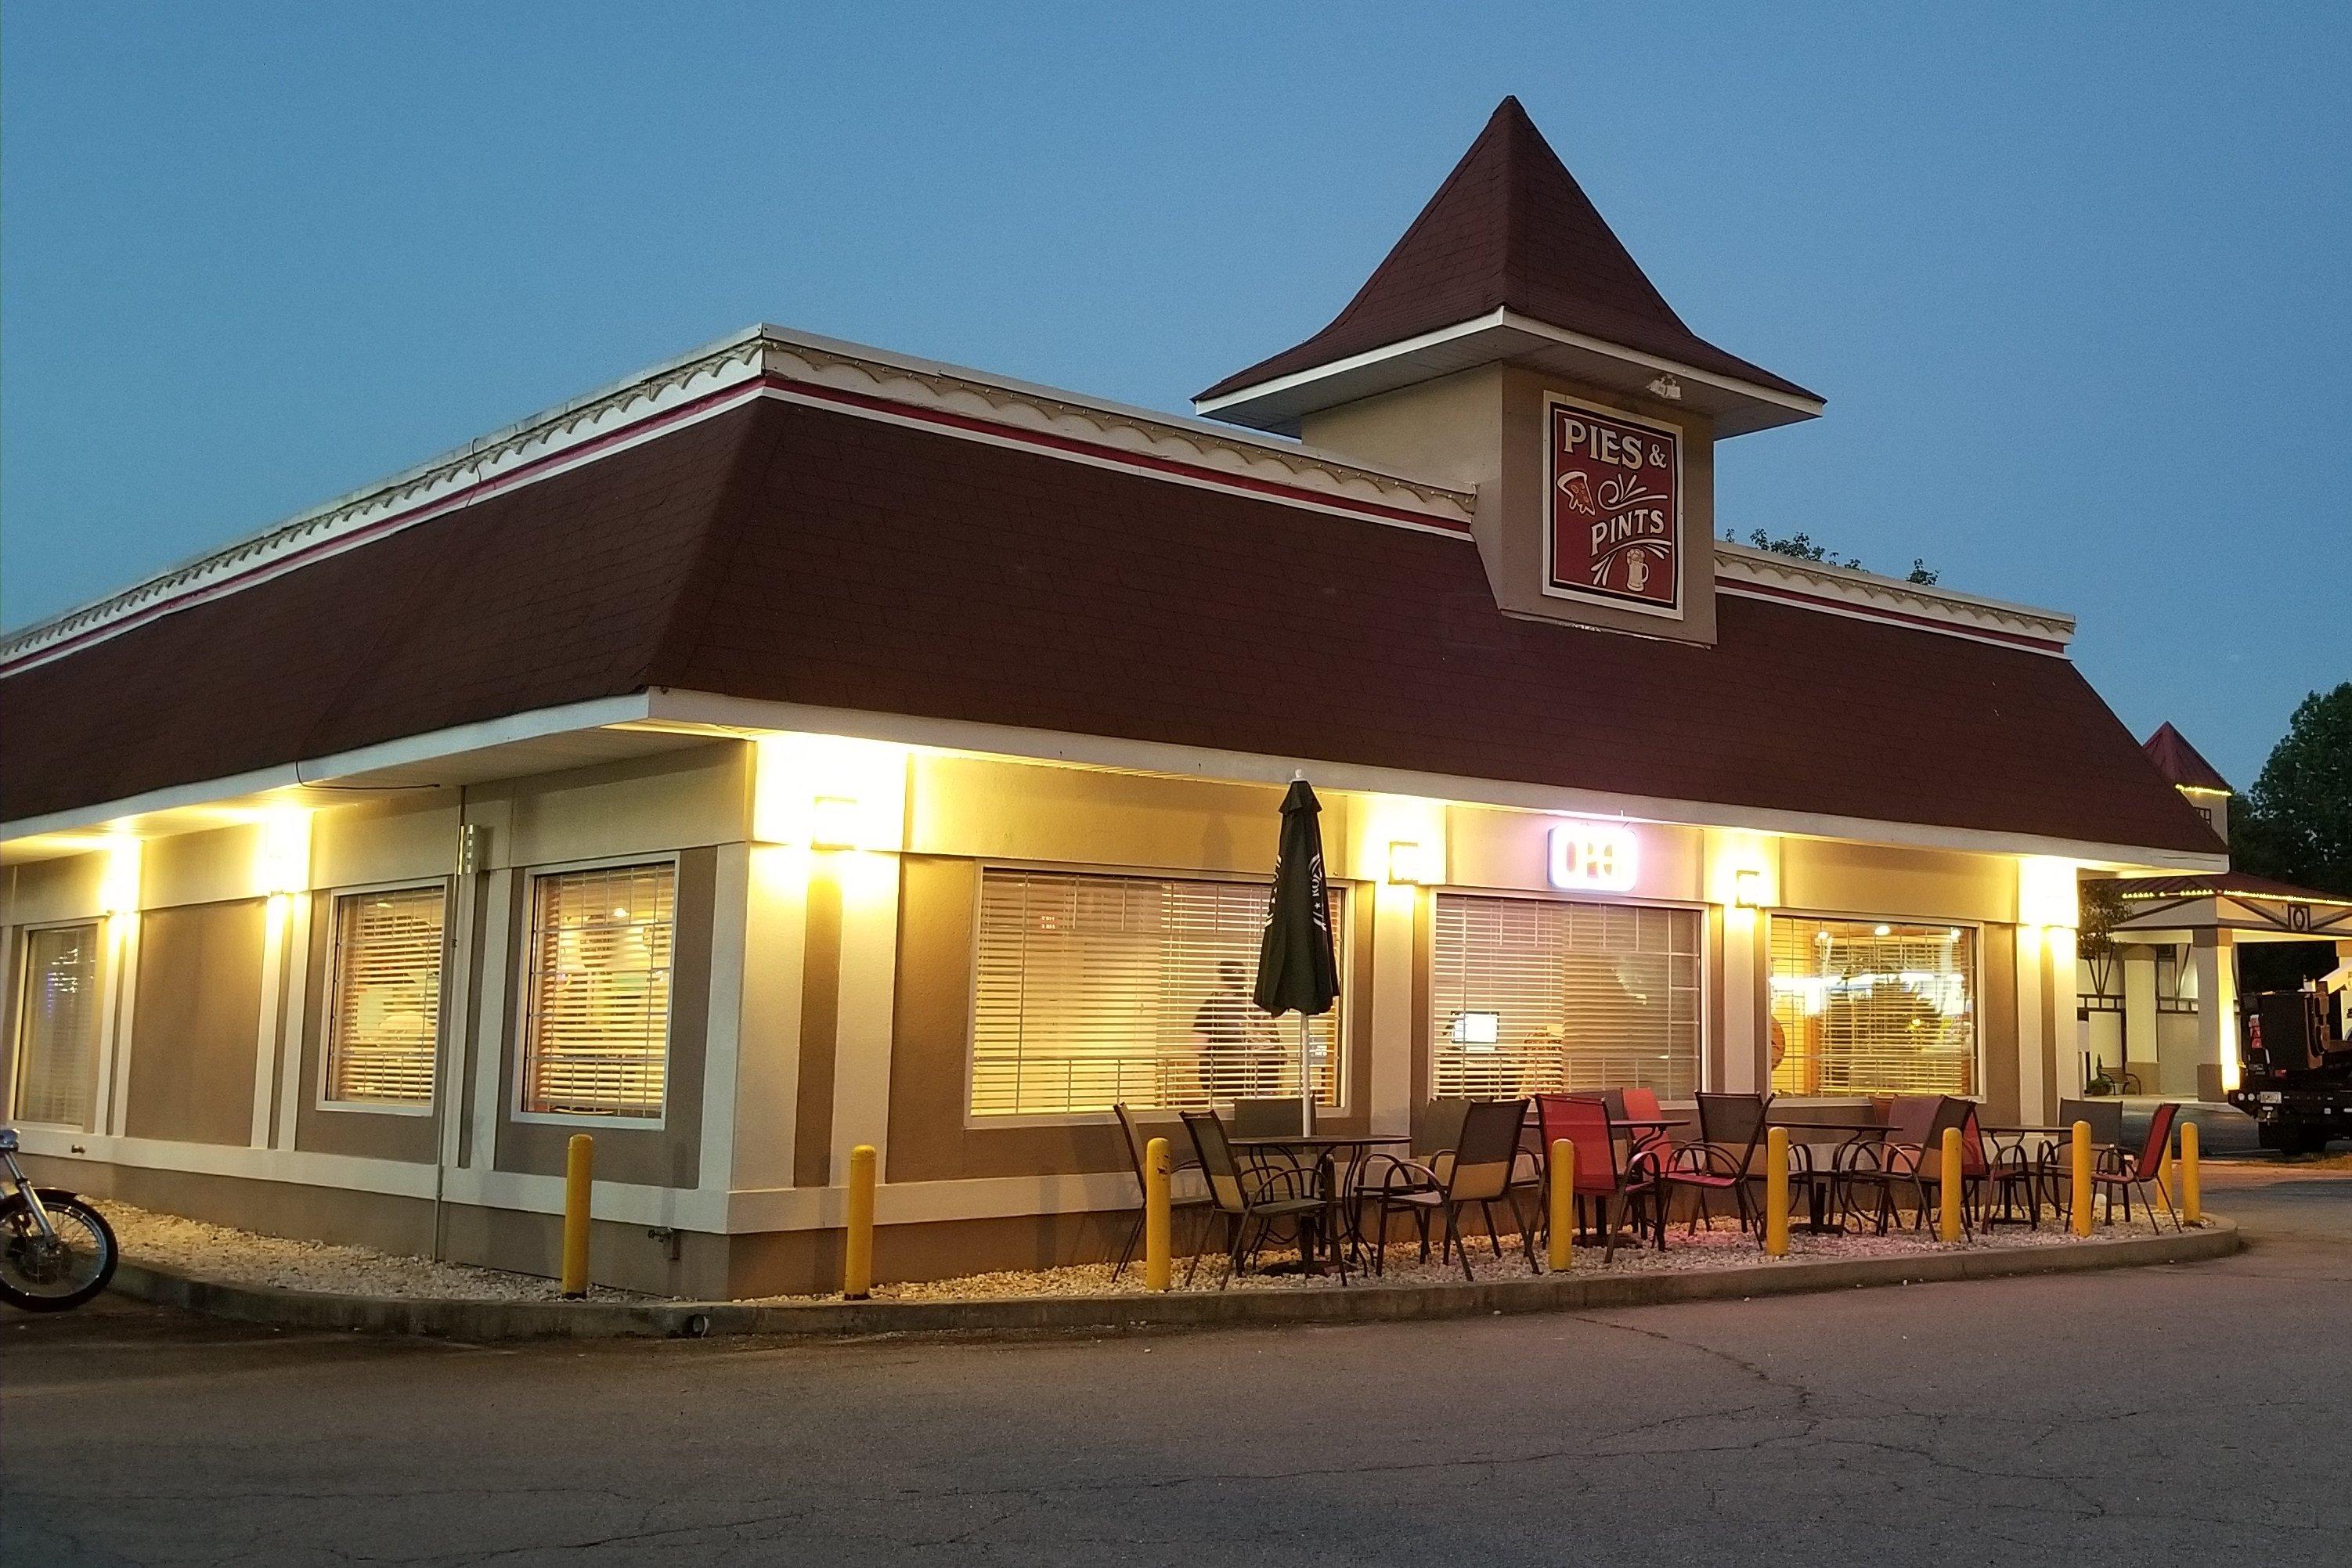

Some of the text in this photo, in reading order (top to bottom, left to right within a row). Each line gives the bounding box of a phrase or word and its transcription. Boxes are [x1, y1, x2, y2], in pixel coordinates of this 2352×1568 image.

[1563, 417, 1667, 470] PIES &
[1590, 508, 1665, 557] PINTS
